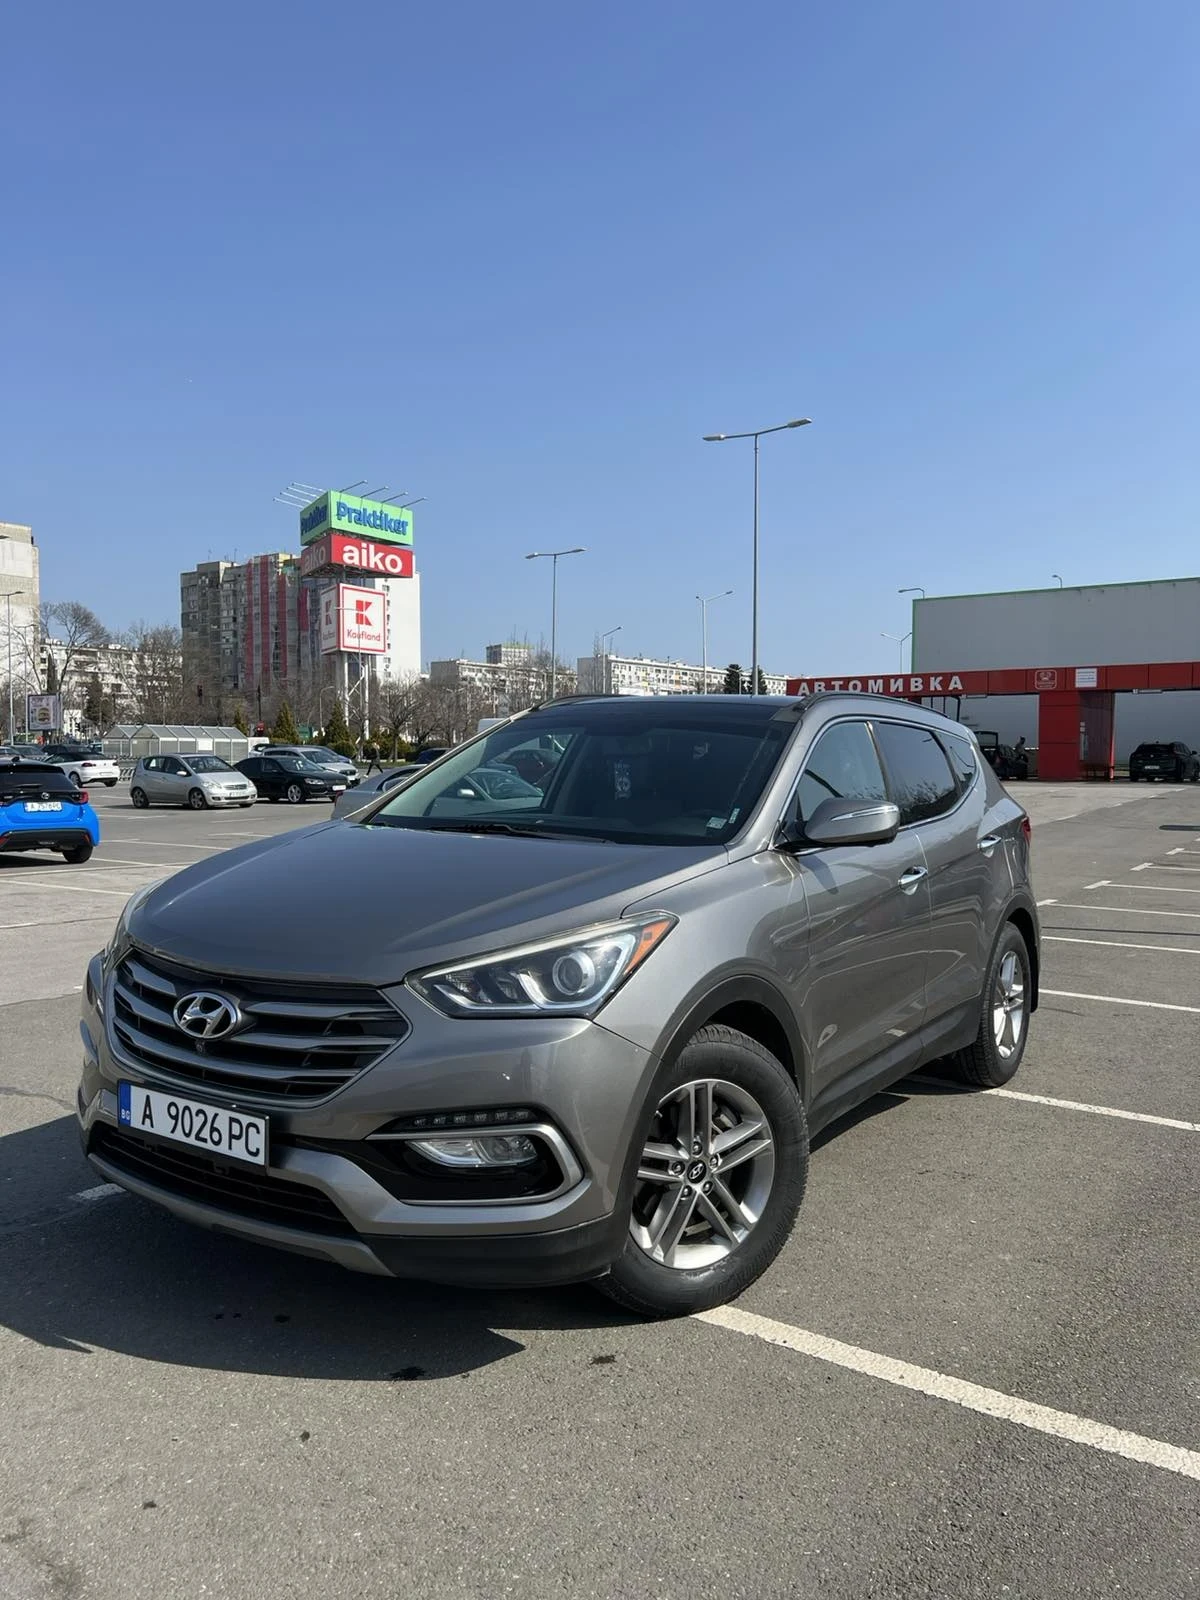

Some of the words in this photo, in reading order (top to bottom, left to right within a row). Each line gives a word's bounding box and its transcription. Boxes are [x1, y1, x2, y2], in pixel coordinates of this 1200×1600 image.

[336, 501, 408, 536] Praktiker
[342, 542, 403, 574] aiko
[355, 599, 372, 626] K
[347, 628, 381, 642] Kaufland
[797, 675, 963, 696] АВТОМИВКА
[120, 1109, 131, 1121] BG
[141, 1094, 154, 1129] A
